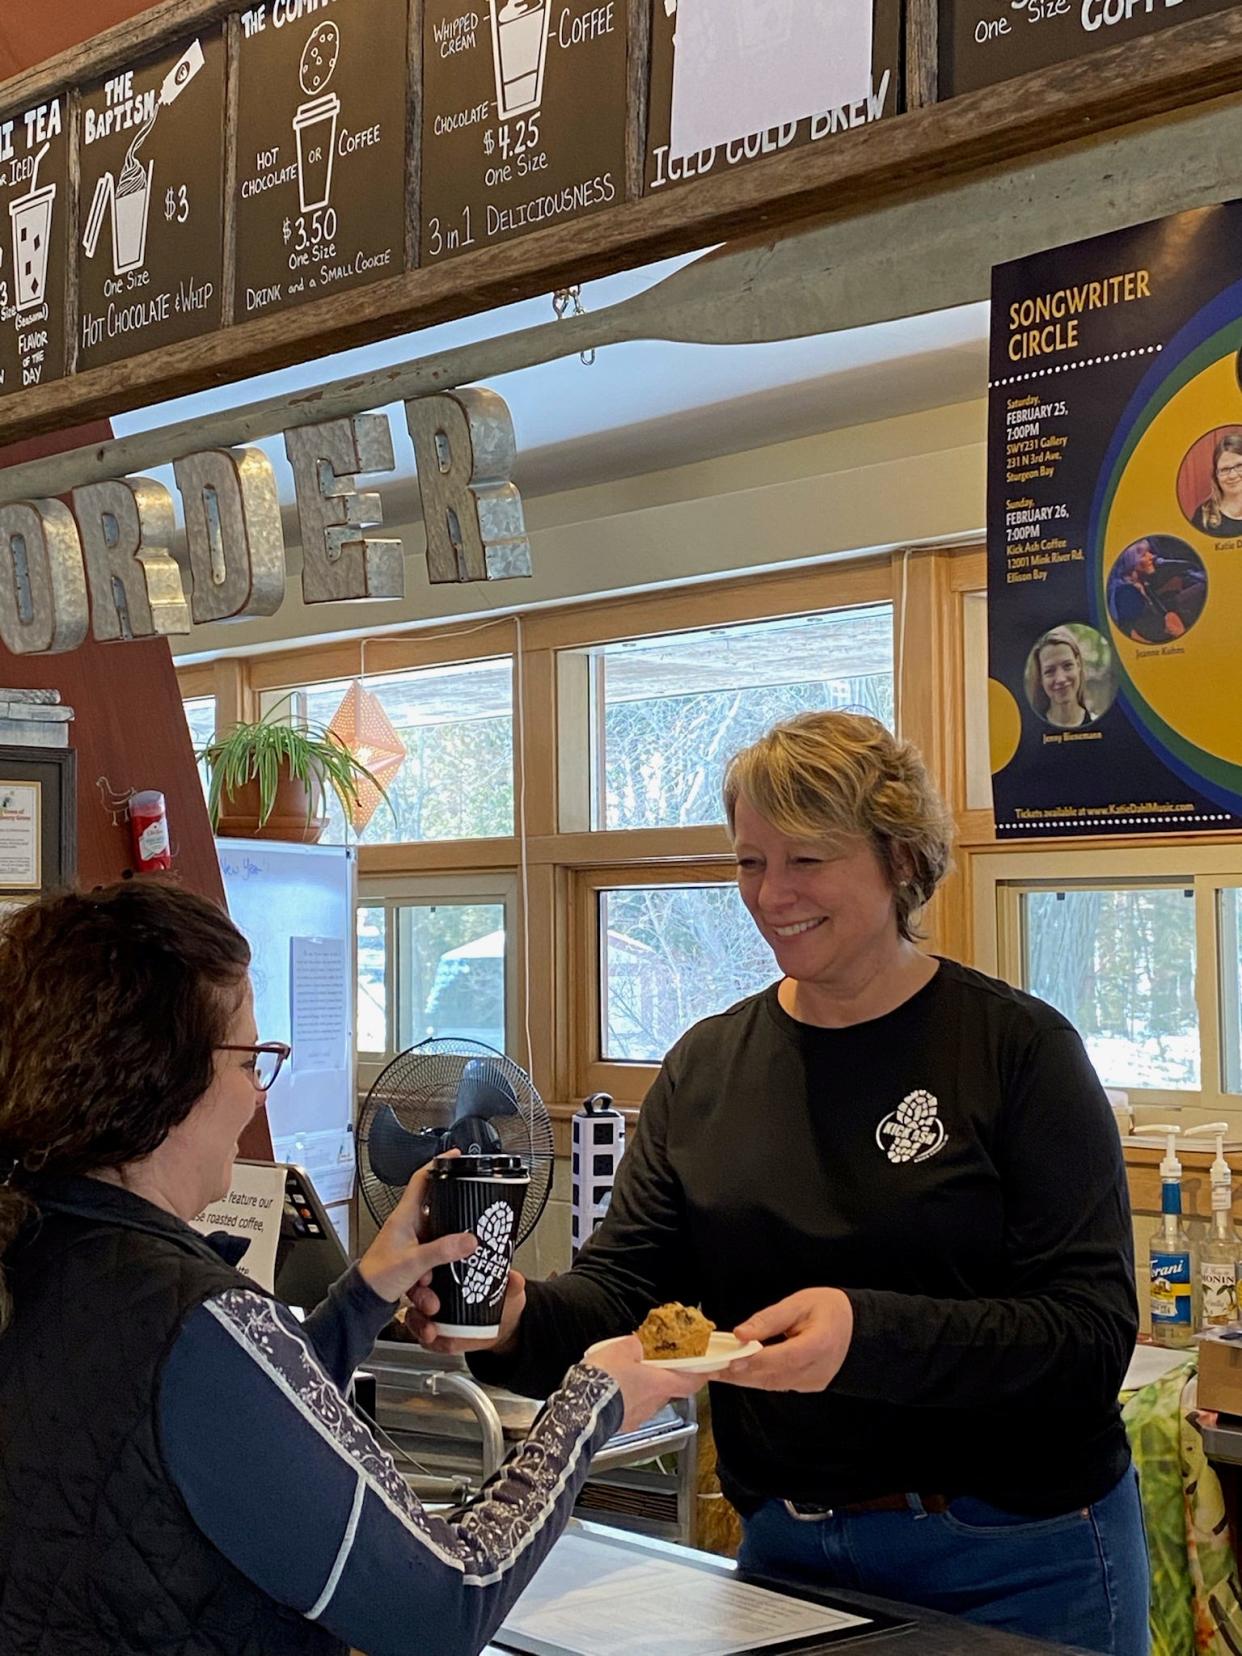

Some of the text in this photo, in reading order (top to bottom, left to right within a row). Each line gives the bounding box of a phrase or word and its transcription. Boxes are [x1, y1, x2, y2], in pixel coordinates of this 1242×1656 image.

[240, 4, 266, 39] THE
[433, 12, 478, 43] WHIPPED
[558, 1, 615, 49] COFFEE
[974, 0, 1071, 43] One Size
[440, 32, 476, 58] CREAM
[104, 70, 134, 107] THE
[24, 98, 62, 149] TEA
[84, 89, 156, 145] BAPTISM
[434, 100, 489, 136] CHOCOLATE
[650, 69, 891, 188] ICED COLD BREW
[338, 124, 381, 157] COFFEE
[483, 111, 542, 161] $4.25
[256, 146, 280, 171] HOT
[308, 146, 322, 164] OR
[484, 151, 549, 187] One Size
[8, 154, 35, 188] ICED
[241, 162, 298, 199] CHOCOLATE
[164, 184, 190, 223] $3
[428, 172, 617, 256] 3 in 1 DELICIOUSNESS
[281, 207, 338, 252] $3.50
[288, 242, 338, 271] One Size
[103, 269, 151, 298] One Size
[246, 248, 392, 312] DRINK and a SMALL COOKIE
[1008, 269, 1151, 331] SONGWRITER
[82, 312, 106, 349] HOT
[106, 292, 171, 338] CHOCOLATE
[18, 330, 49, 355] FLAVOR
[1008, 318, 1079, 362] CIRCLE
[22, 350, 45, 368] OF THE
[22, 364, 42, 386] DAY
[1006, 401, 1069, 426] FEBRUARY 25,
[1006, 421, 1040, 441] 7:00PM
[1006, 435, 1068, 455] SWY231 Gallery
[1006, 450, 1062, 469] 231 N 3rd Ave.
[1006, 465, 1055, 483] Sturgeon Bay
[0, 386, 532, 655] ORDER
[1006, 503, 1070, 526] FEBRUARY 26,
[1006, 523, 1041, 542] 7:00PM
[1006, 537, 1067, 556] Kick Ash Coffee
[1051, 552, 1071, 564] River
[1032, 568, 1048, 581] Bay
[1015, 808, 1043, 819] Tickets
[1043, 806, 1077, 818] available
[1078, 807, 1087, 816] at
[229, 1190, 258, 1207] feature
[258, 1197, 274, 1209] our
[206, 1213, 238, 1228] roasted
[238, 1216, 265, 1233] coffee,
[474, 1246, 509, 1269] CK ASH
